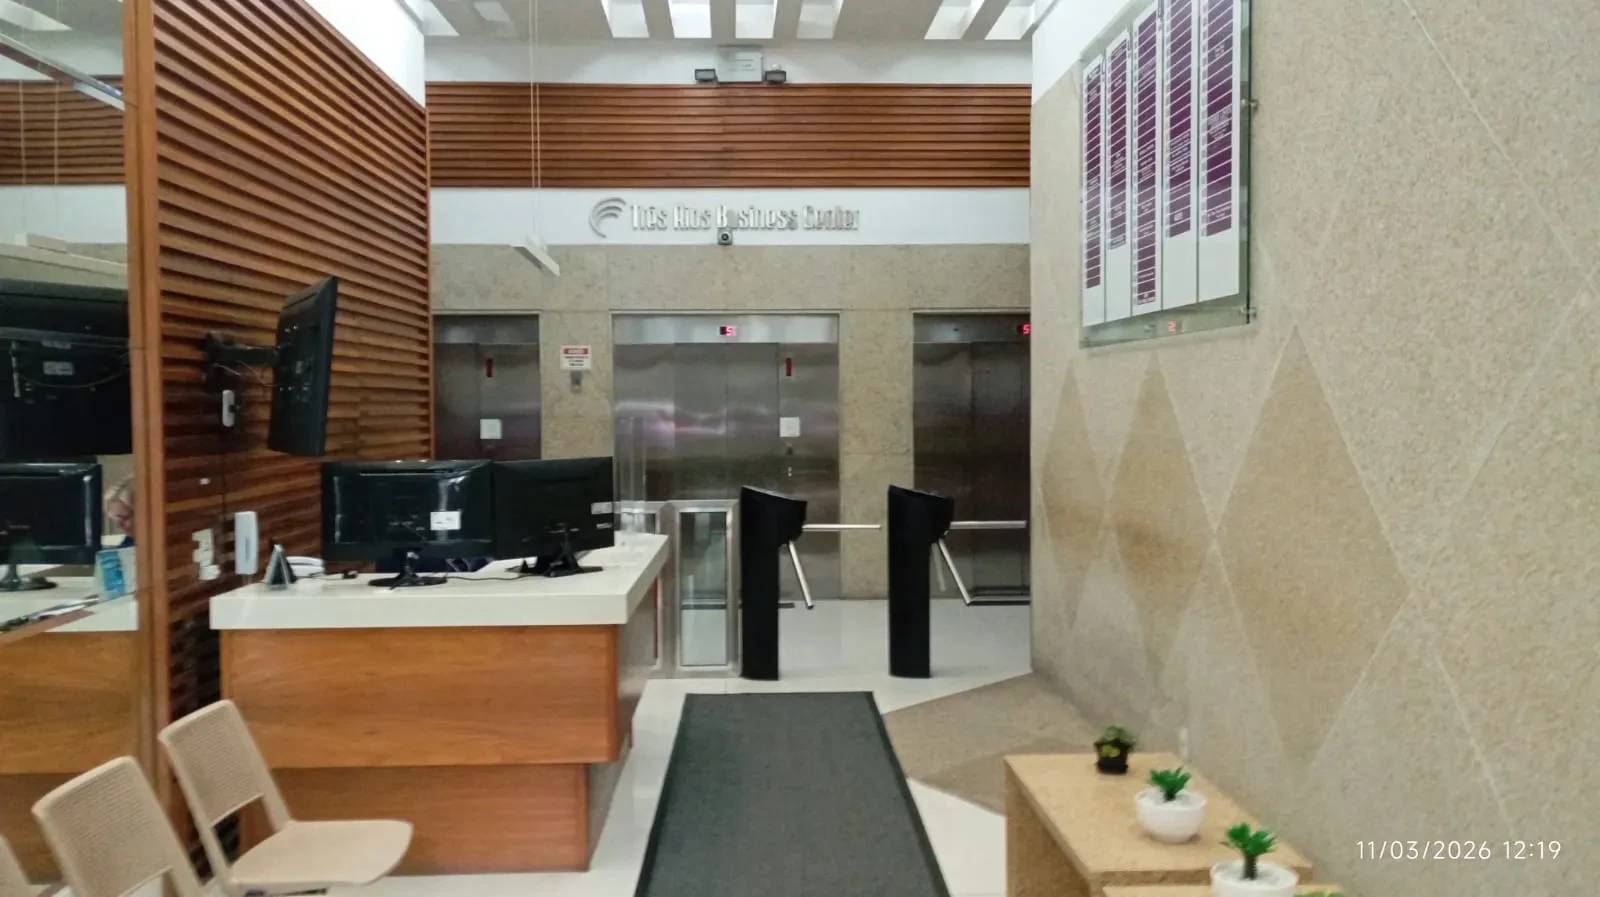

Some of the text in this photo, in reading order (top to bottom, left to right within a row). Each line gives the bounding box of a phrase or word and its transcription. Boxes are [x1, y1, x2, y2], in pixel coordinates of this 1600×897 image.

[630, 204, 667, 230] Três
[673, 204, 711, 230] Rios
[802, 205, 860, 230] Center
